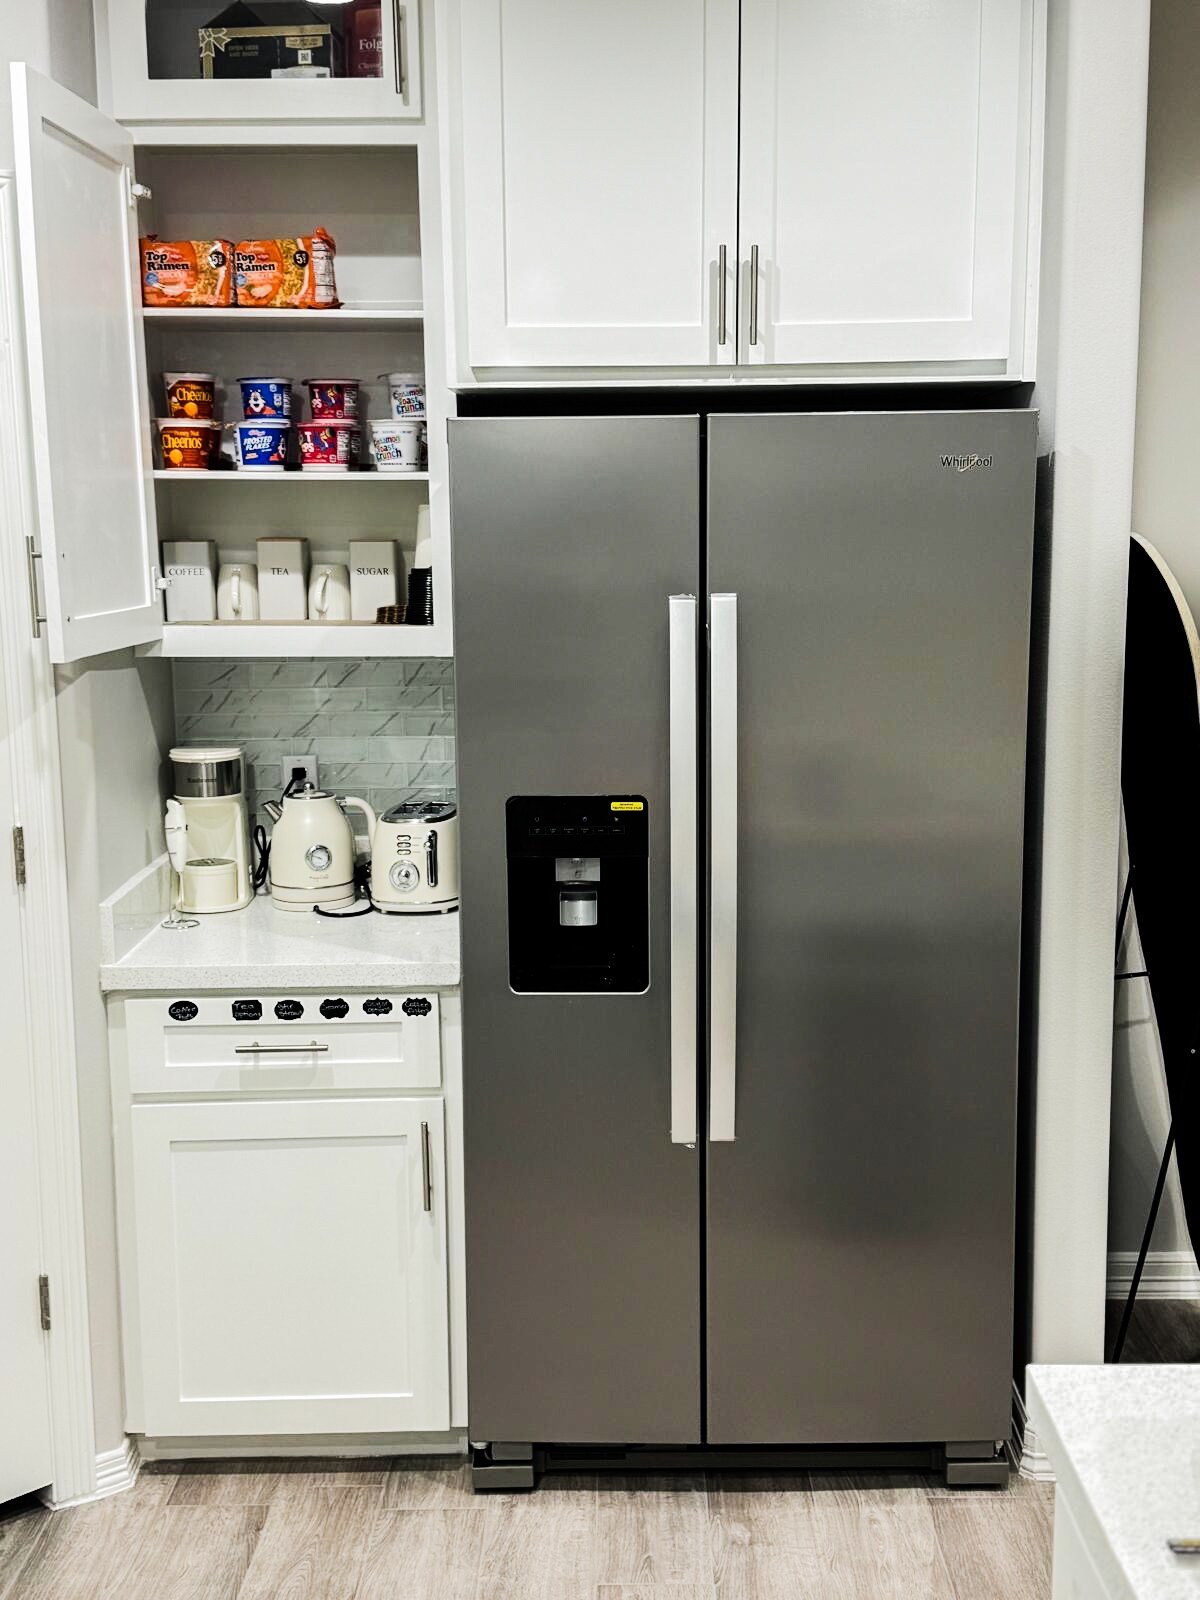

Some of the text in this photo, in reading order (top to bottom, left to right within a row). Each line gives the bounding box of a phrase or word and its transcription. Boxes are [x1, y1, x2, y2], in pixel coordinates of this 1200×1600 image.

[145, 251, 168, 264] Top
[236, 252, 257, 264] Top
[147, 261, 189, 271] Ramen
[237, 262, 276, 272] Ramen
[161, 433, 203, 449] Cheerios
[941, 455, 993, 470] Whirlpool
[168, 567, 206, 576] COFFEE
[271, 567, 289, 576] TEA
[356, 567, 390, 576] SUGAR
[233, 1002, 255, 1011] Tea
